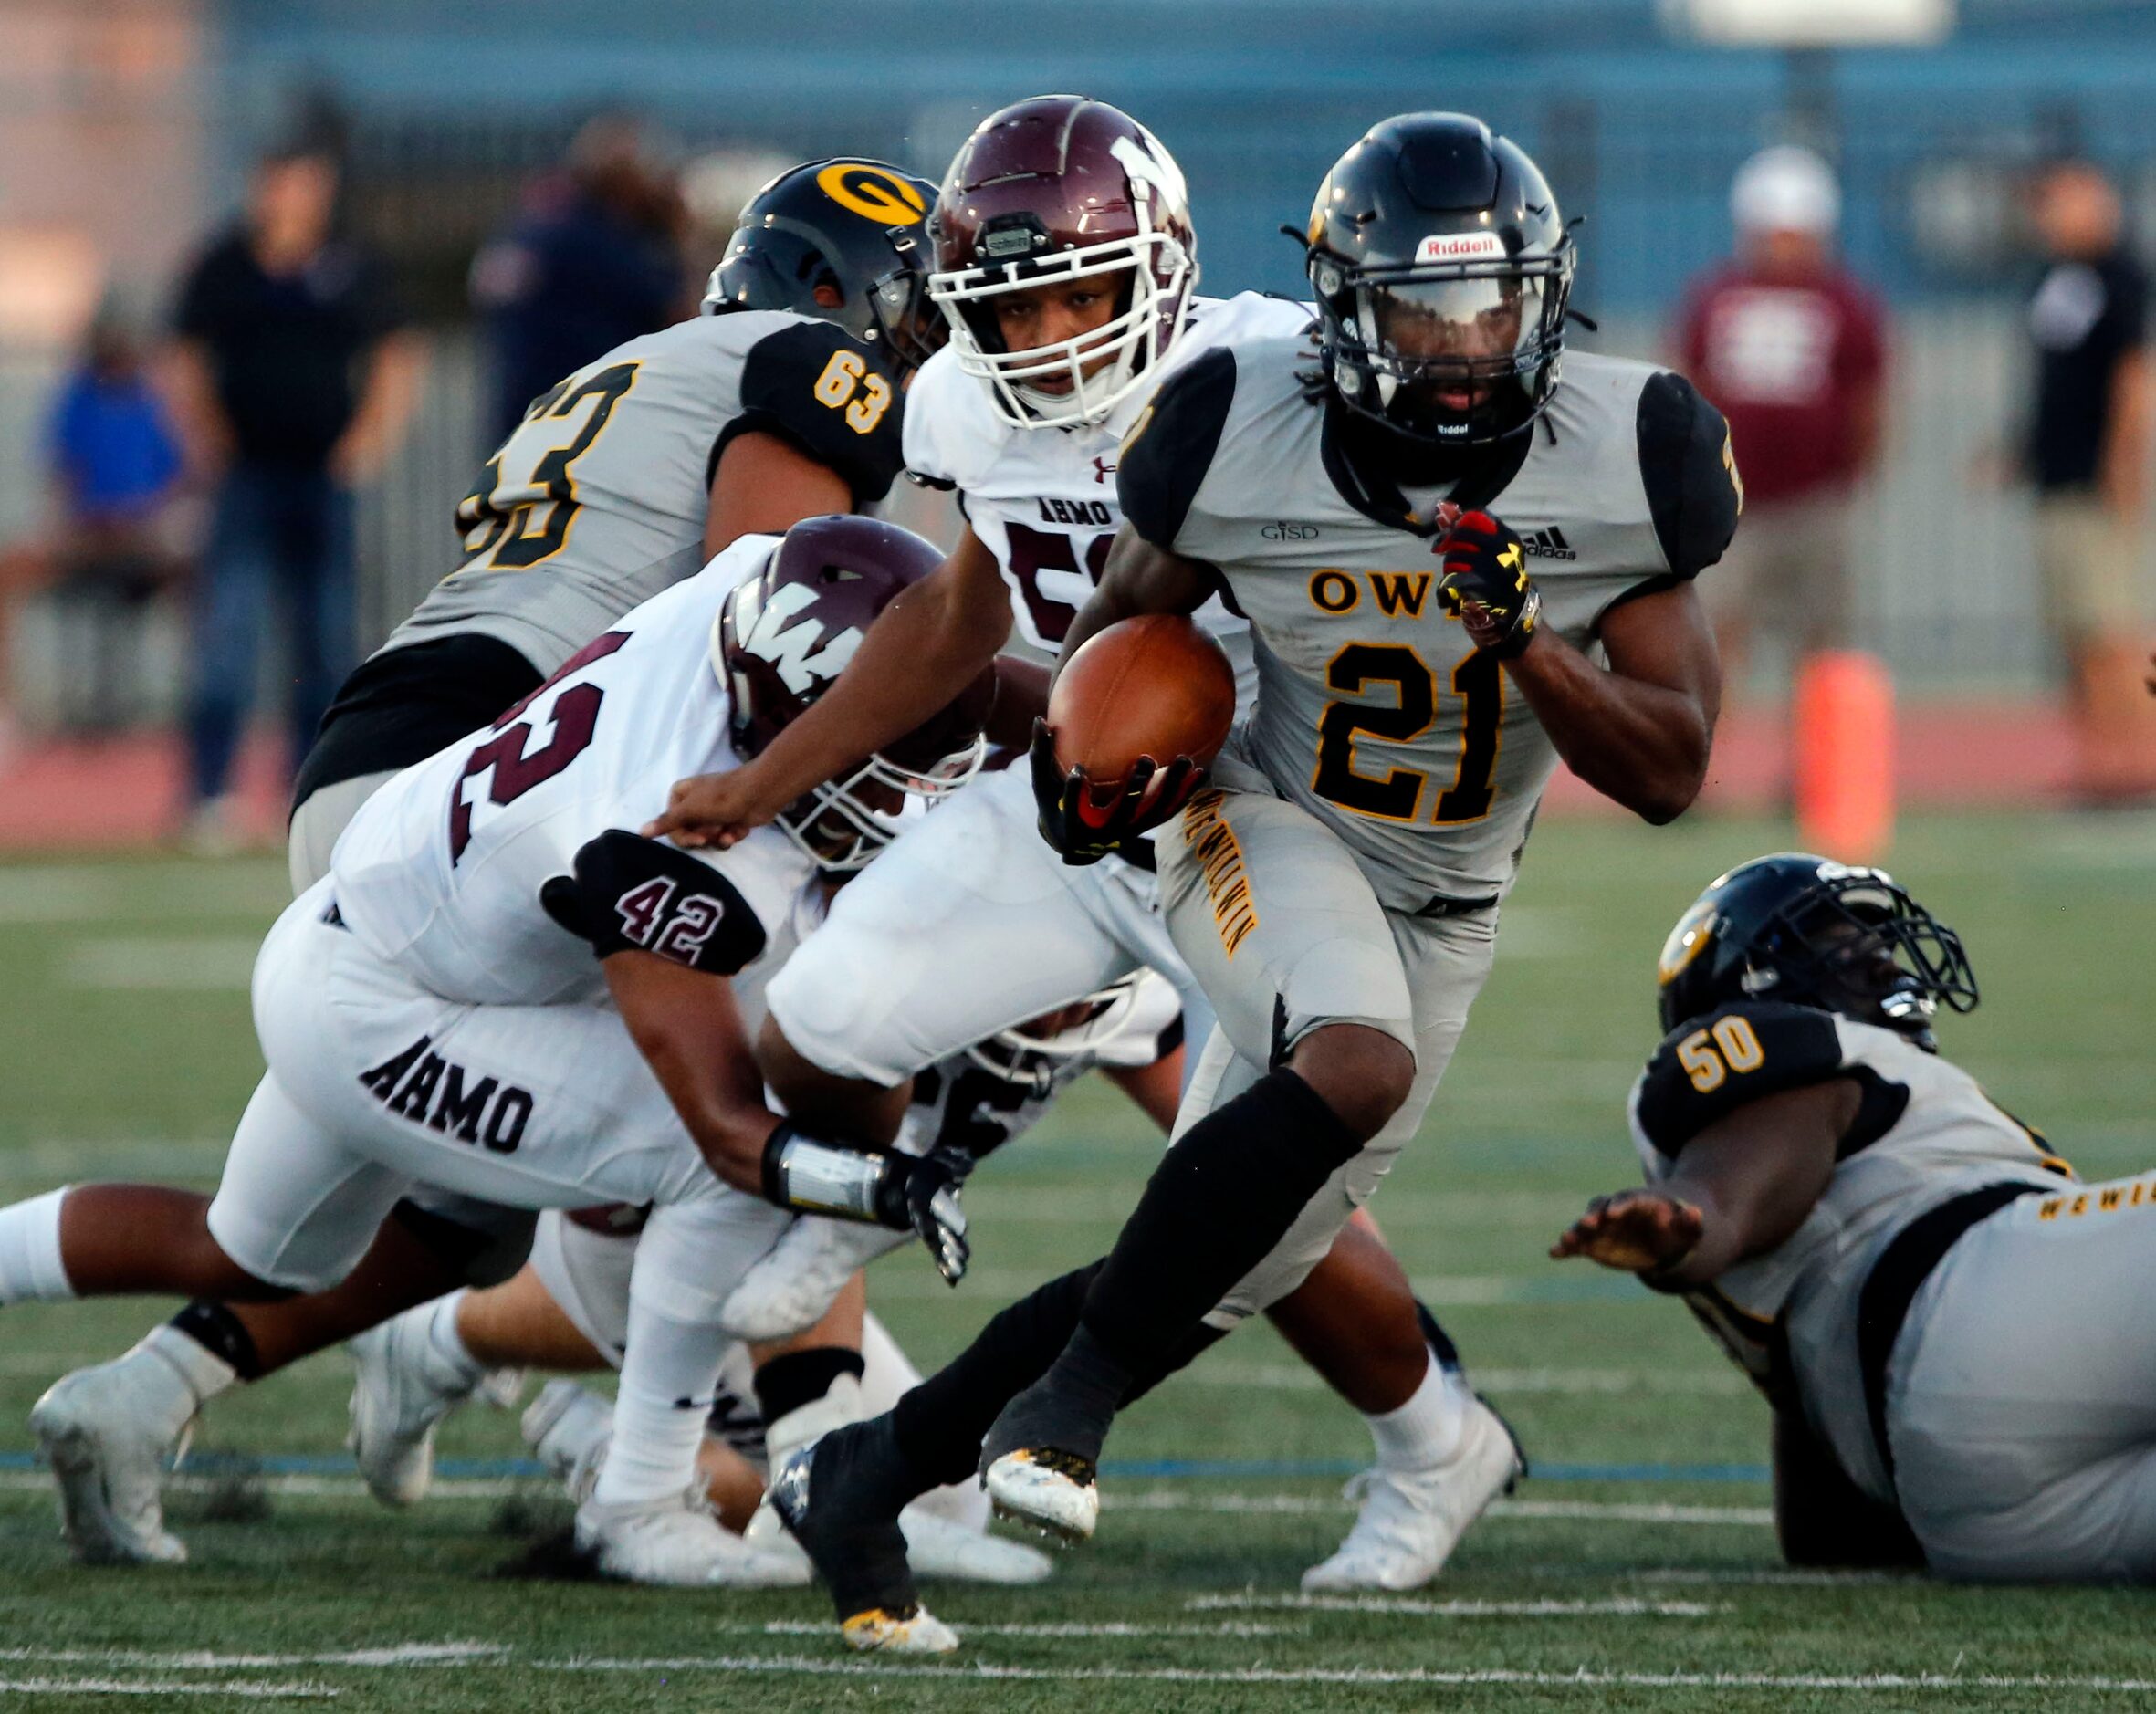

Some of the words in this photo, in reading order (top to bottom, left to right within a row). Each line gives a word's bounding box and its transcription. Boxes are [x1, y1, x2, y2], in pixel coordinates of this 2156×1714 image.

[814, 350, 892, 434] 63
[1312, 642, 1505, 825] 21
[614, 876, 724, 966] 42
[1676, 1015, 1765, 1093] 50
